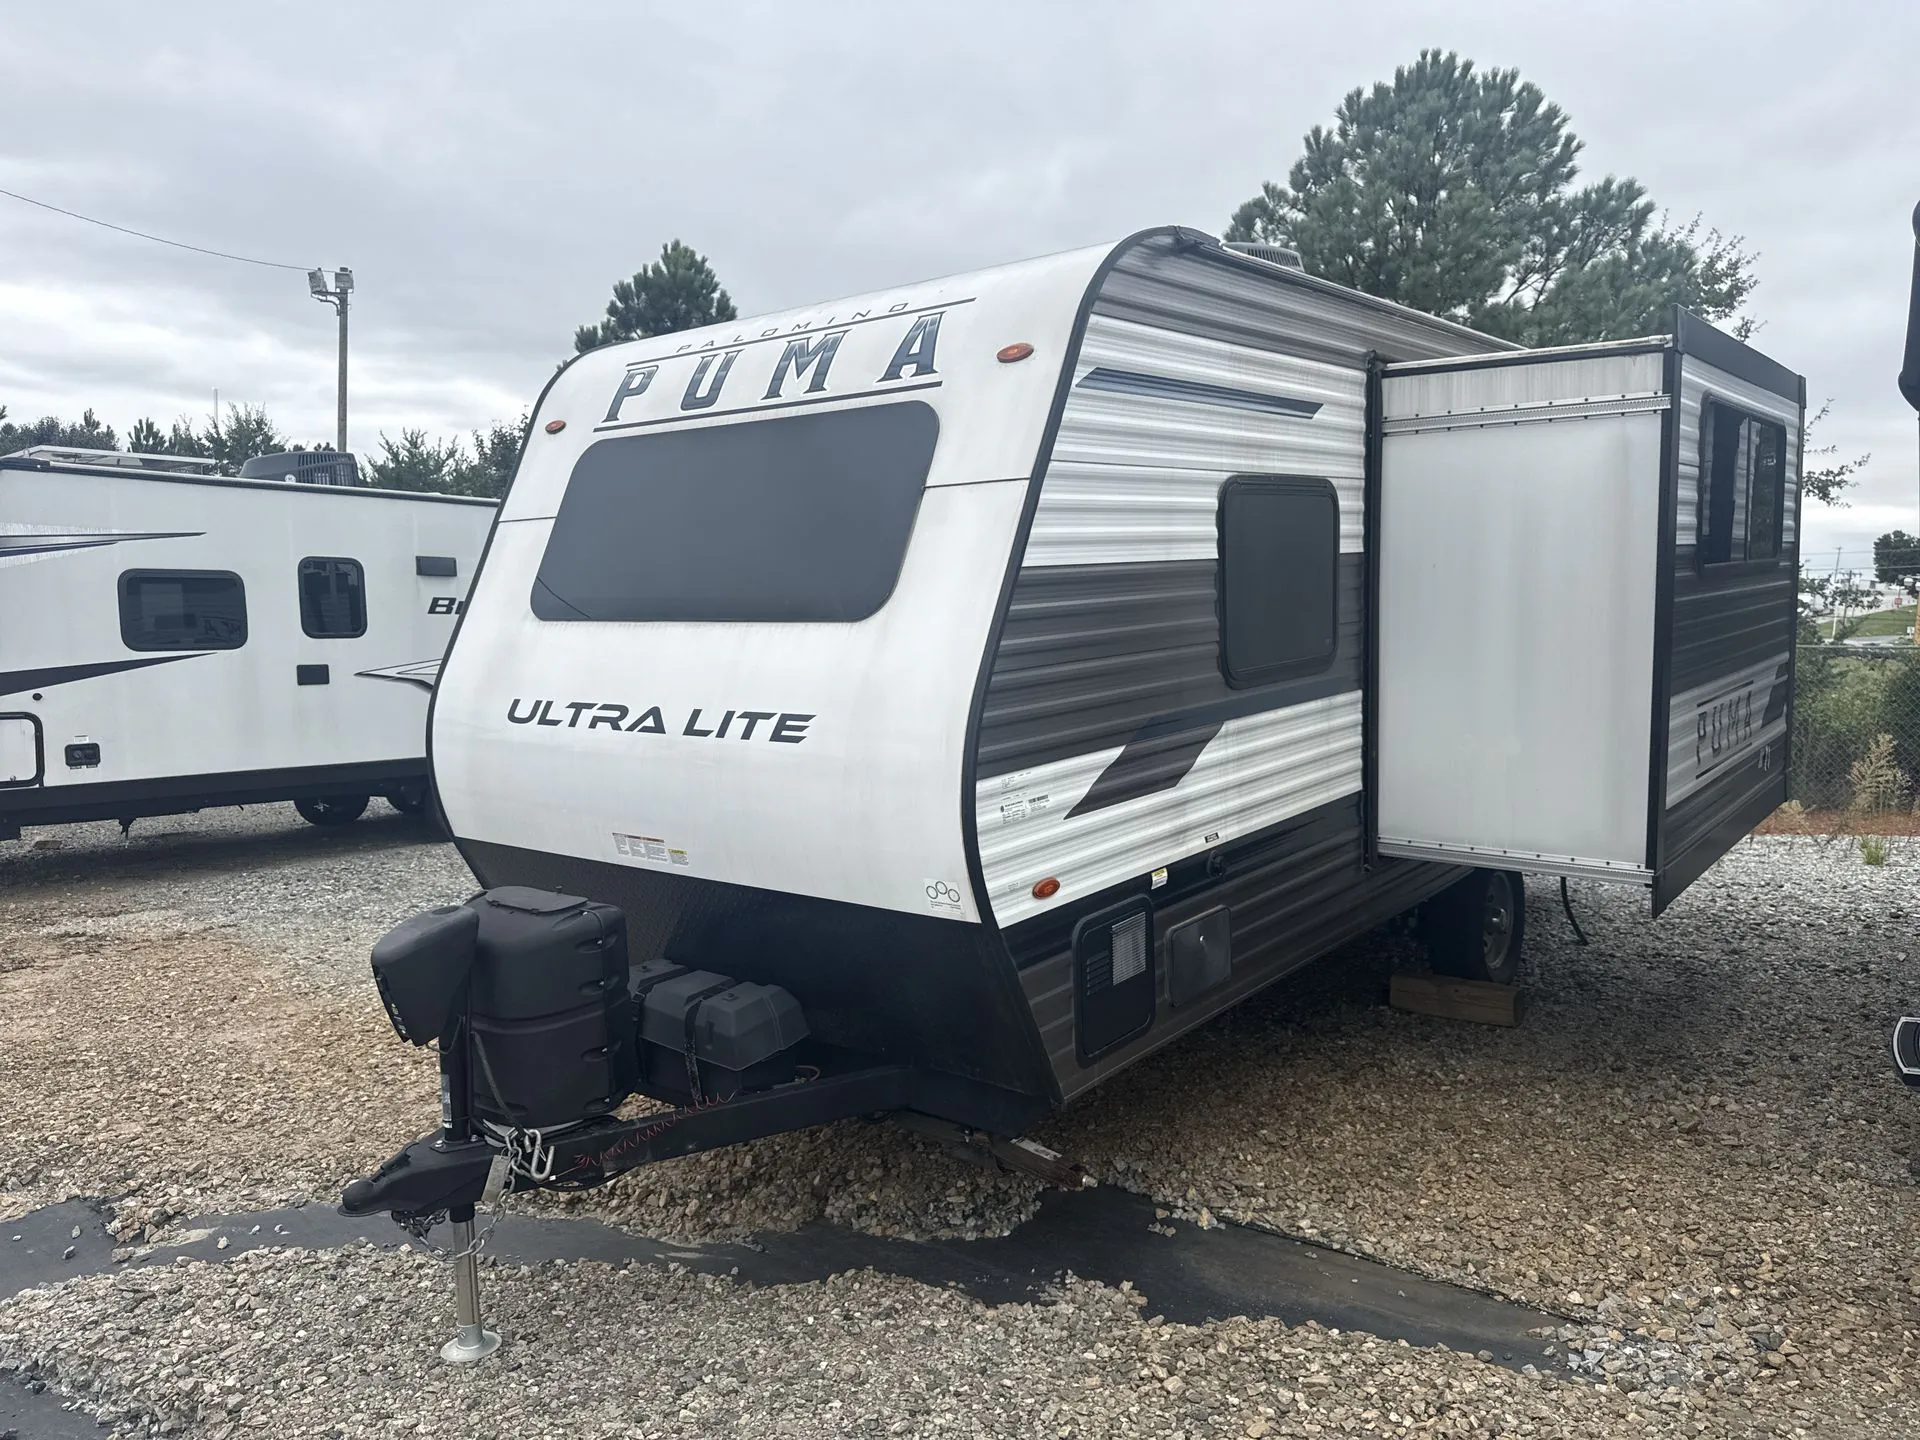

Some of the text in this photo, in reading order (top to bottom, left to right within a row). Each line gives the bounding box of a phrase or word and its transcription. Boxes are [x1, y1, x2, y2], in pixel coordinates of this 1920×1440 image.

[676, 302, 909, 352] PALOMINO
[601, 311, 946, 423] PUMA
[507, 698, 817, 744] ULTRA LITE
[1697, 691, 1752, 765] PUMA
